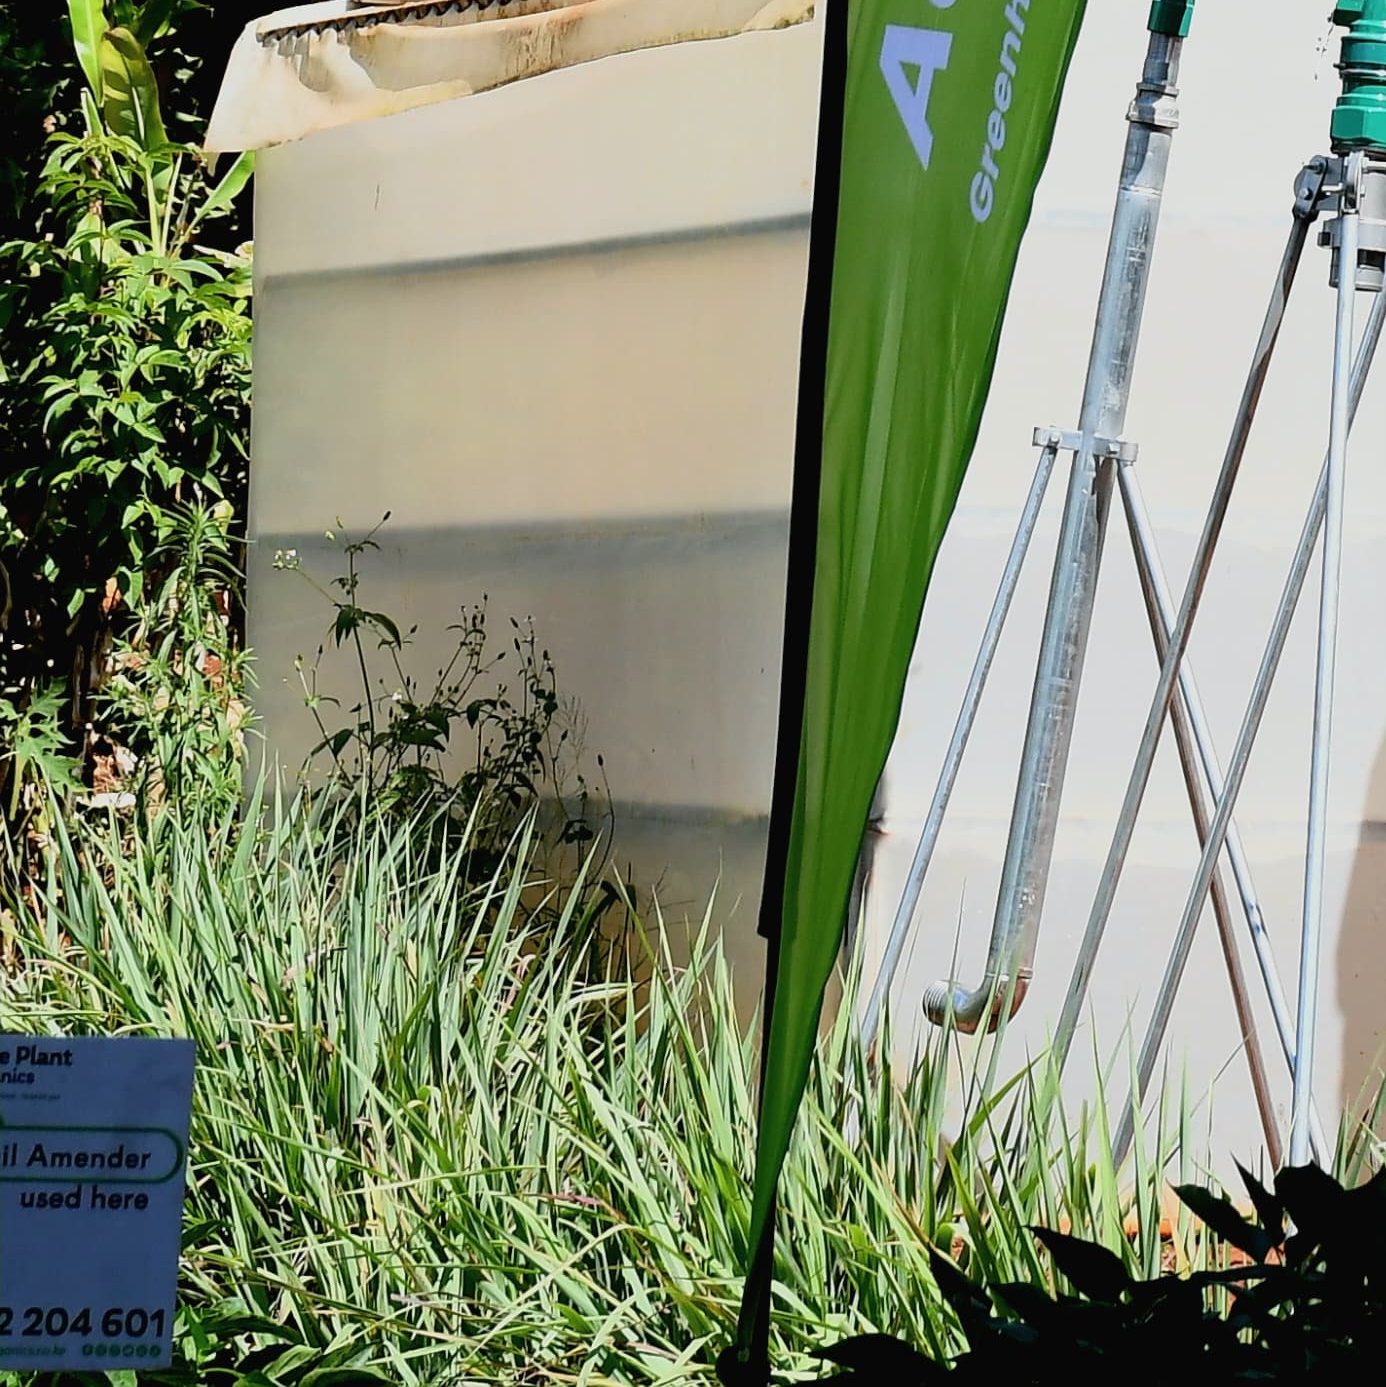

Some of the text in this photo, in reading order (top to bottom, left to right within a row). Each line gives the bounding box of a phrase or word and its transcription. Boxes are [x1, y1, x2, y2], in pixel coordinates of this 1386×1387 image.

[16, 1044, 73, 1066] Plant
[26, 1143, 152, 1170] Amender
[20, 1184, 149, 1211] used here
[21, 1307, 93, 1337] 204
[101, 1308, 166, 1338] 601
